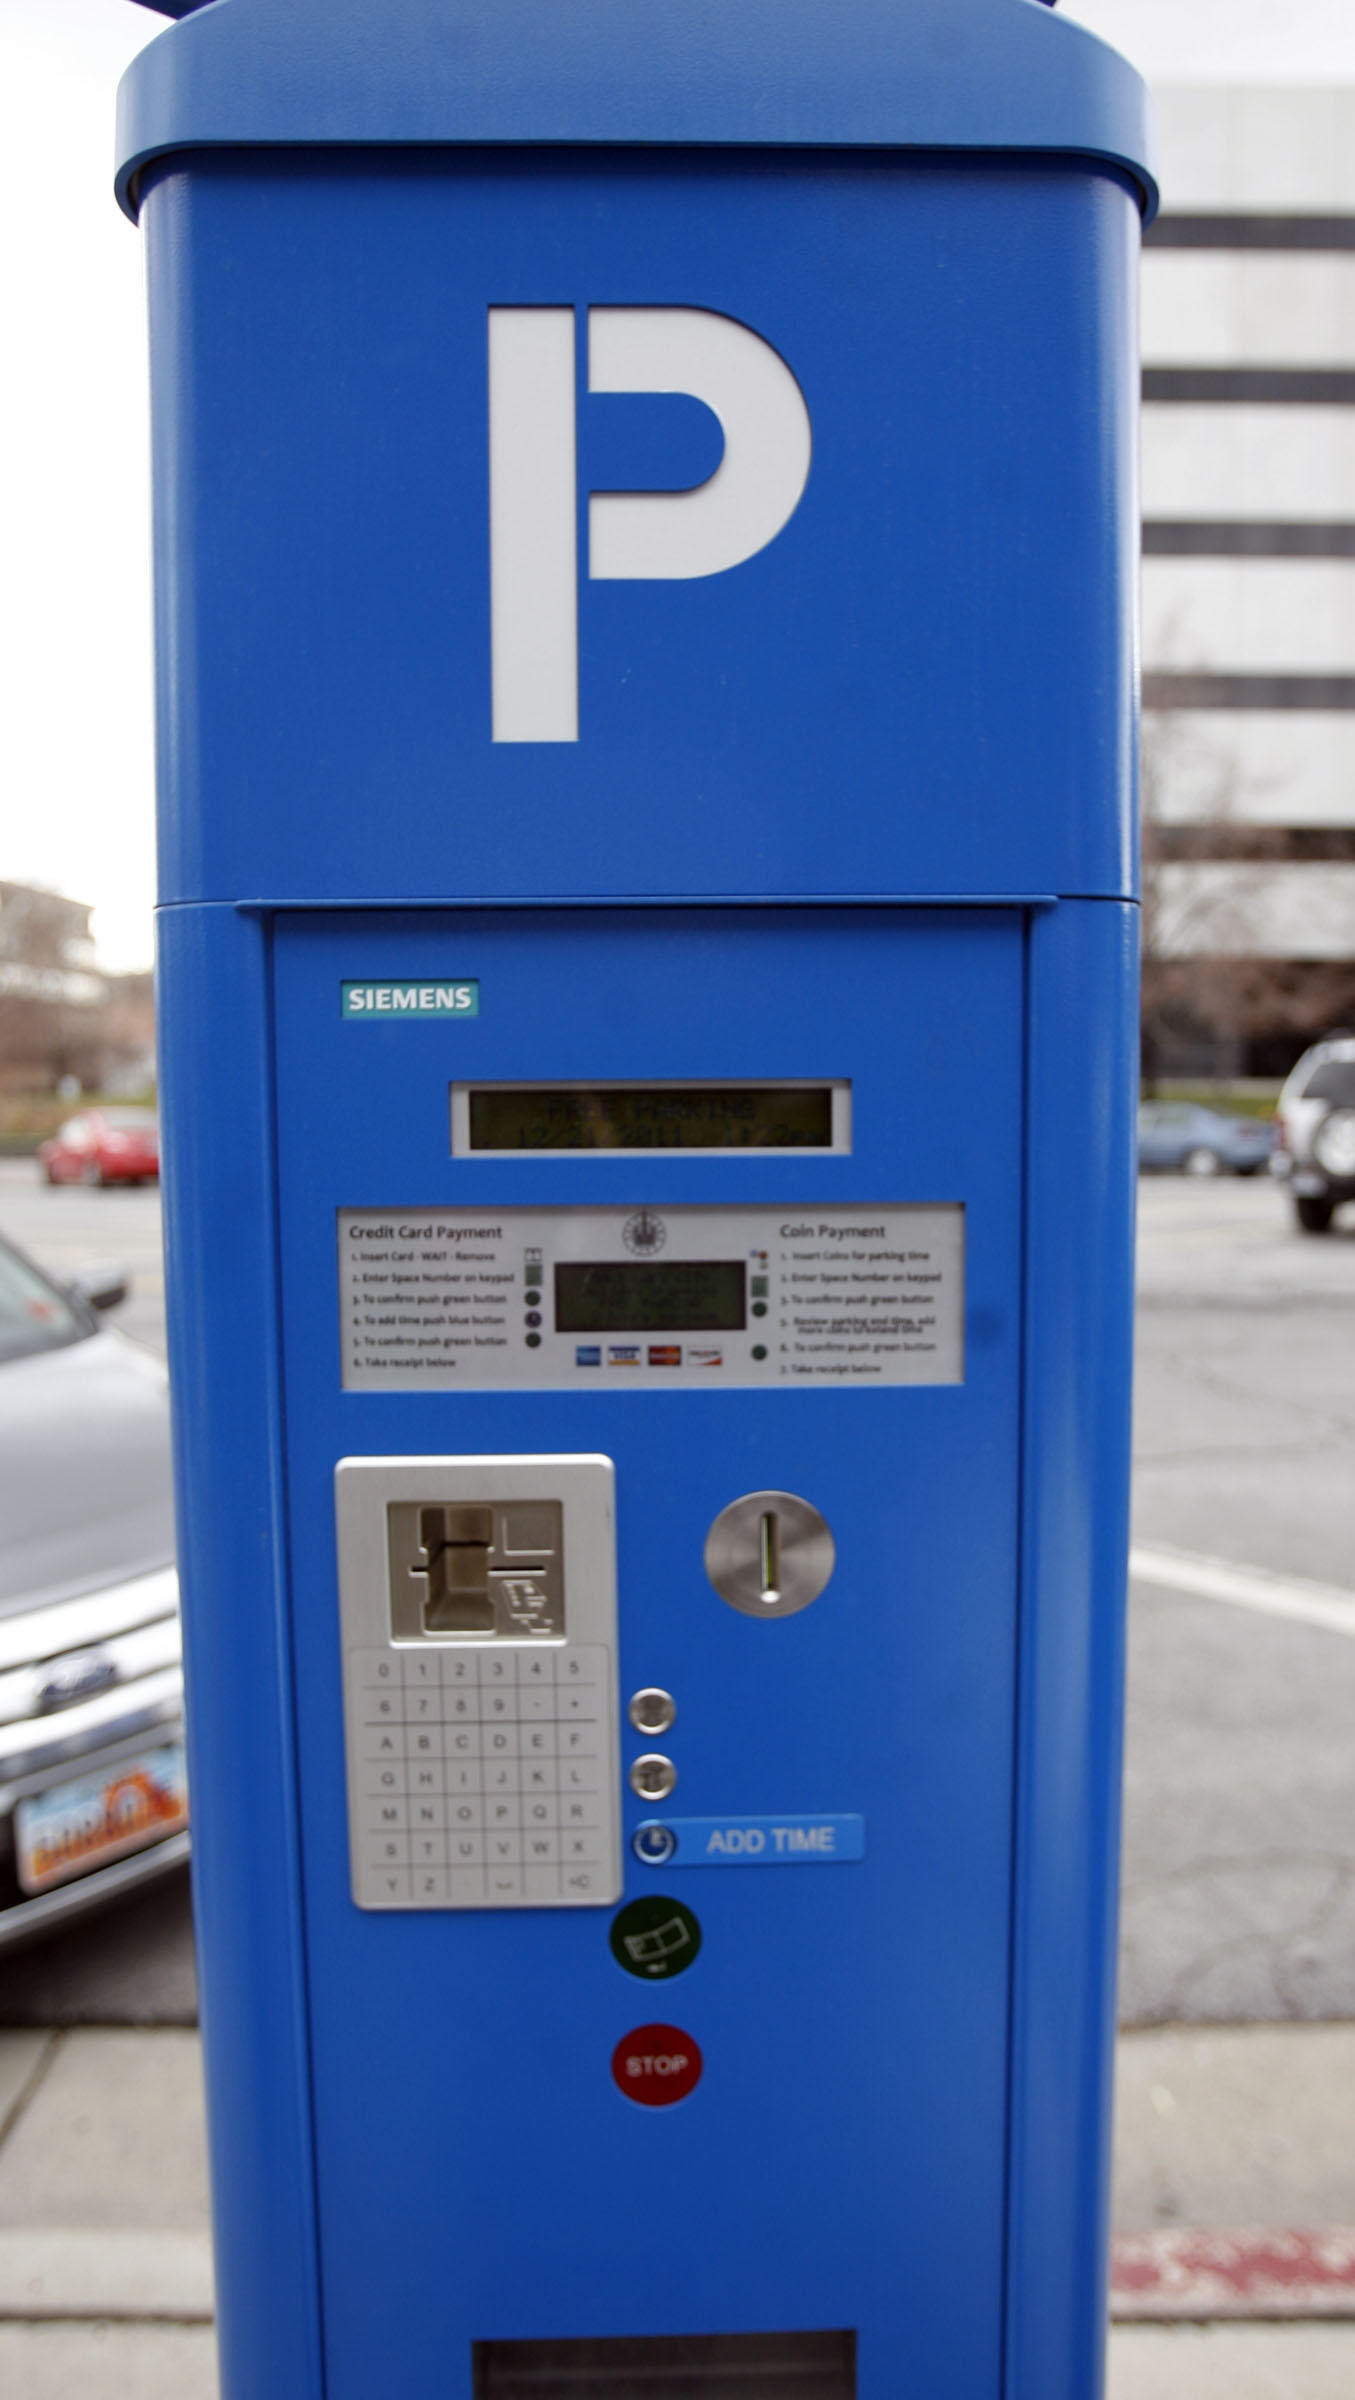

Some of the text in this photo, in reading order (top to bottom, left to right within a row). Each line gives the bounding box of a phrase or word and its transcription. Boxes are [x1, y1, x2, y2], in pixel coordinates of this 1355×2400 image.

[488, 304, 811, 743] P
[348, 987, 472, 1010] SIEMENS
[349, 1225, 503, 1242] Credit Card Payment
[779, 1224, 886, 1241] Coin Payment
[360, 1251, 388, 1261] Insert
[391, 1251, 414, 1261] Card
[421, 1251, 447, 1261] WAIT
[455, 1251, 496, 1261] Remove
[363, 1273, 388, 1283] Enter
[391, 1273, 420, 1284] Space
[422, 1272, 461, 1283] Number
[464, 1274, 477, 1283] on
[479, 1272, 515, 1284] keypad
[791, 1272, 816, 1282] Enter
[820, 1272, 848, 1284] Space
[851, 1272, 889, 1282] Number
[892, 1274, 904, 1282] on
[906, 1272, 942, 1284] keypad
[363, 1294, 375, 1303] To
[377, 1294, 415, 1303] confirm
[417, 1294, 440, 1305] push
[442, 1296, 471, 1306] green
[473, 1294, 506, 1303] button
[791, 1295, 803, 1304] To
[805, 1294, 842, 1304] confirm
[845, 1294, 868, 1306] push
[870, 1296, 898, 1306] green
[901, 1294, 934, 1304] button
[364, 1316, 375, 1325] To
[378, 1315, 396, 1325] add
[398, 1315, 420, 1325] time
[422, 1315, 445, 1327] push
[448, 1315, 469, 1325] blue
[471, 1315, 505, 1325] button
[364, 1337, 375, 1346] To
[377, 1336, 416, 1346] confirm
[418, 1336, 441, 1348] push
[443, 1337, 472, 1348] green
[474, 1336, 507, 1346] button
[364, 1357, 388, 1367] Take
[389, 1357, 424, 1369] receipt
[426, 1357, 456, 1367] below
[377, 1660, 580, 1679] 0 1 2 3 4 5
[379, 1698, 505, 1714] 6 7 8 9
[380, 1732, 580, 1750] A B C D E F
[381, 1769, 581, 1787] G H I J K L
[381, 1803, 583, 1822] M N O P Q R
[385, 1840, 584, 1857] S T U V W X
[706, 1826, 836, 1854] ADD TIME
[386, 1877, 398, 1892] Y
[424, 1877, 436, 1893] Z
[626, 2054, 688, 2077] STOP
